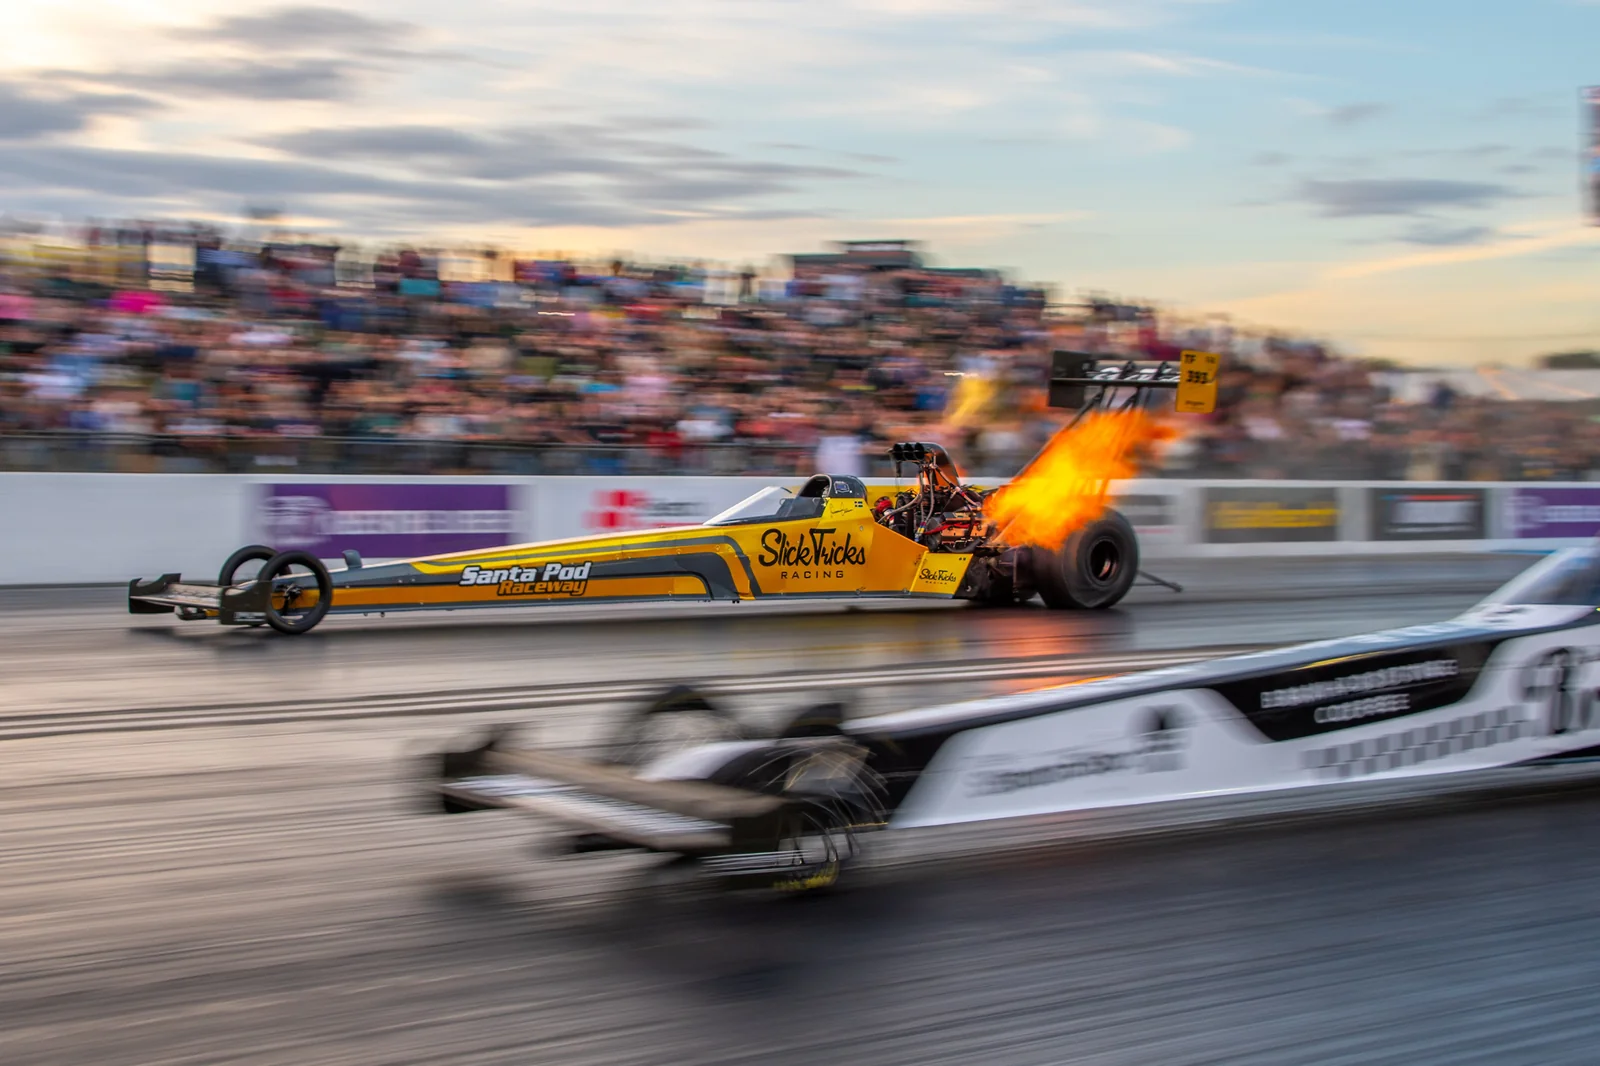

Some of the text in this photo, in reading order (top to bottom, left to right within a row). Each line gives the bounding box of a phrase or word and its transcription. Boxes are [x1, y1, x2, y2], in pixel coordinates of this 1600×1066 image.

[460, 561, 592, 586] Santa Pod
[780, 570, 844, 579] RACING
[498, 580, 587, 595] Raceway
